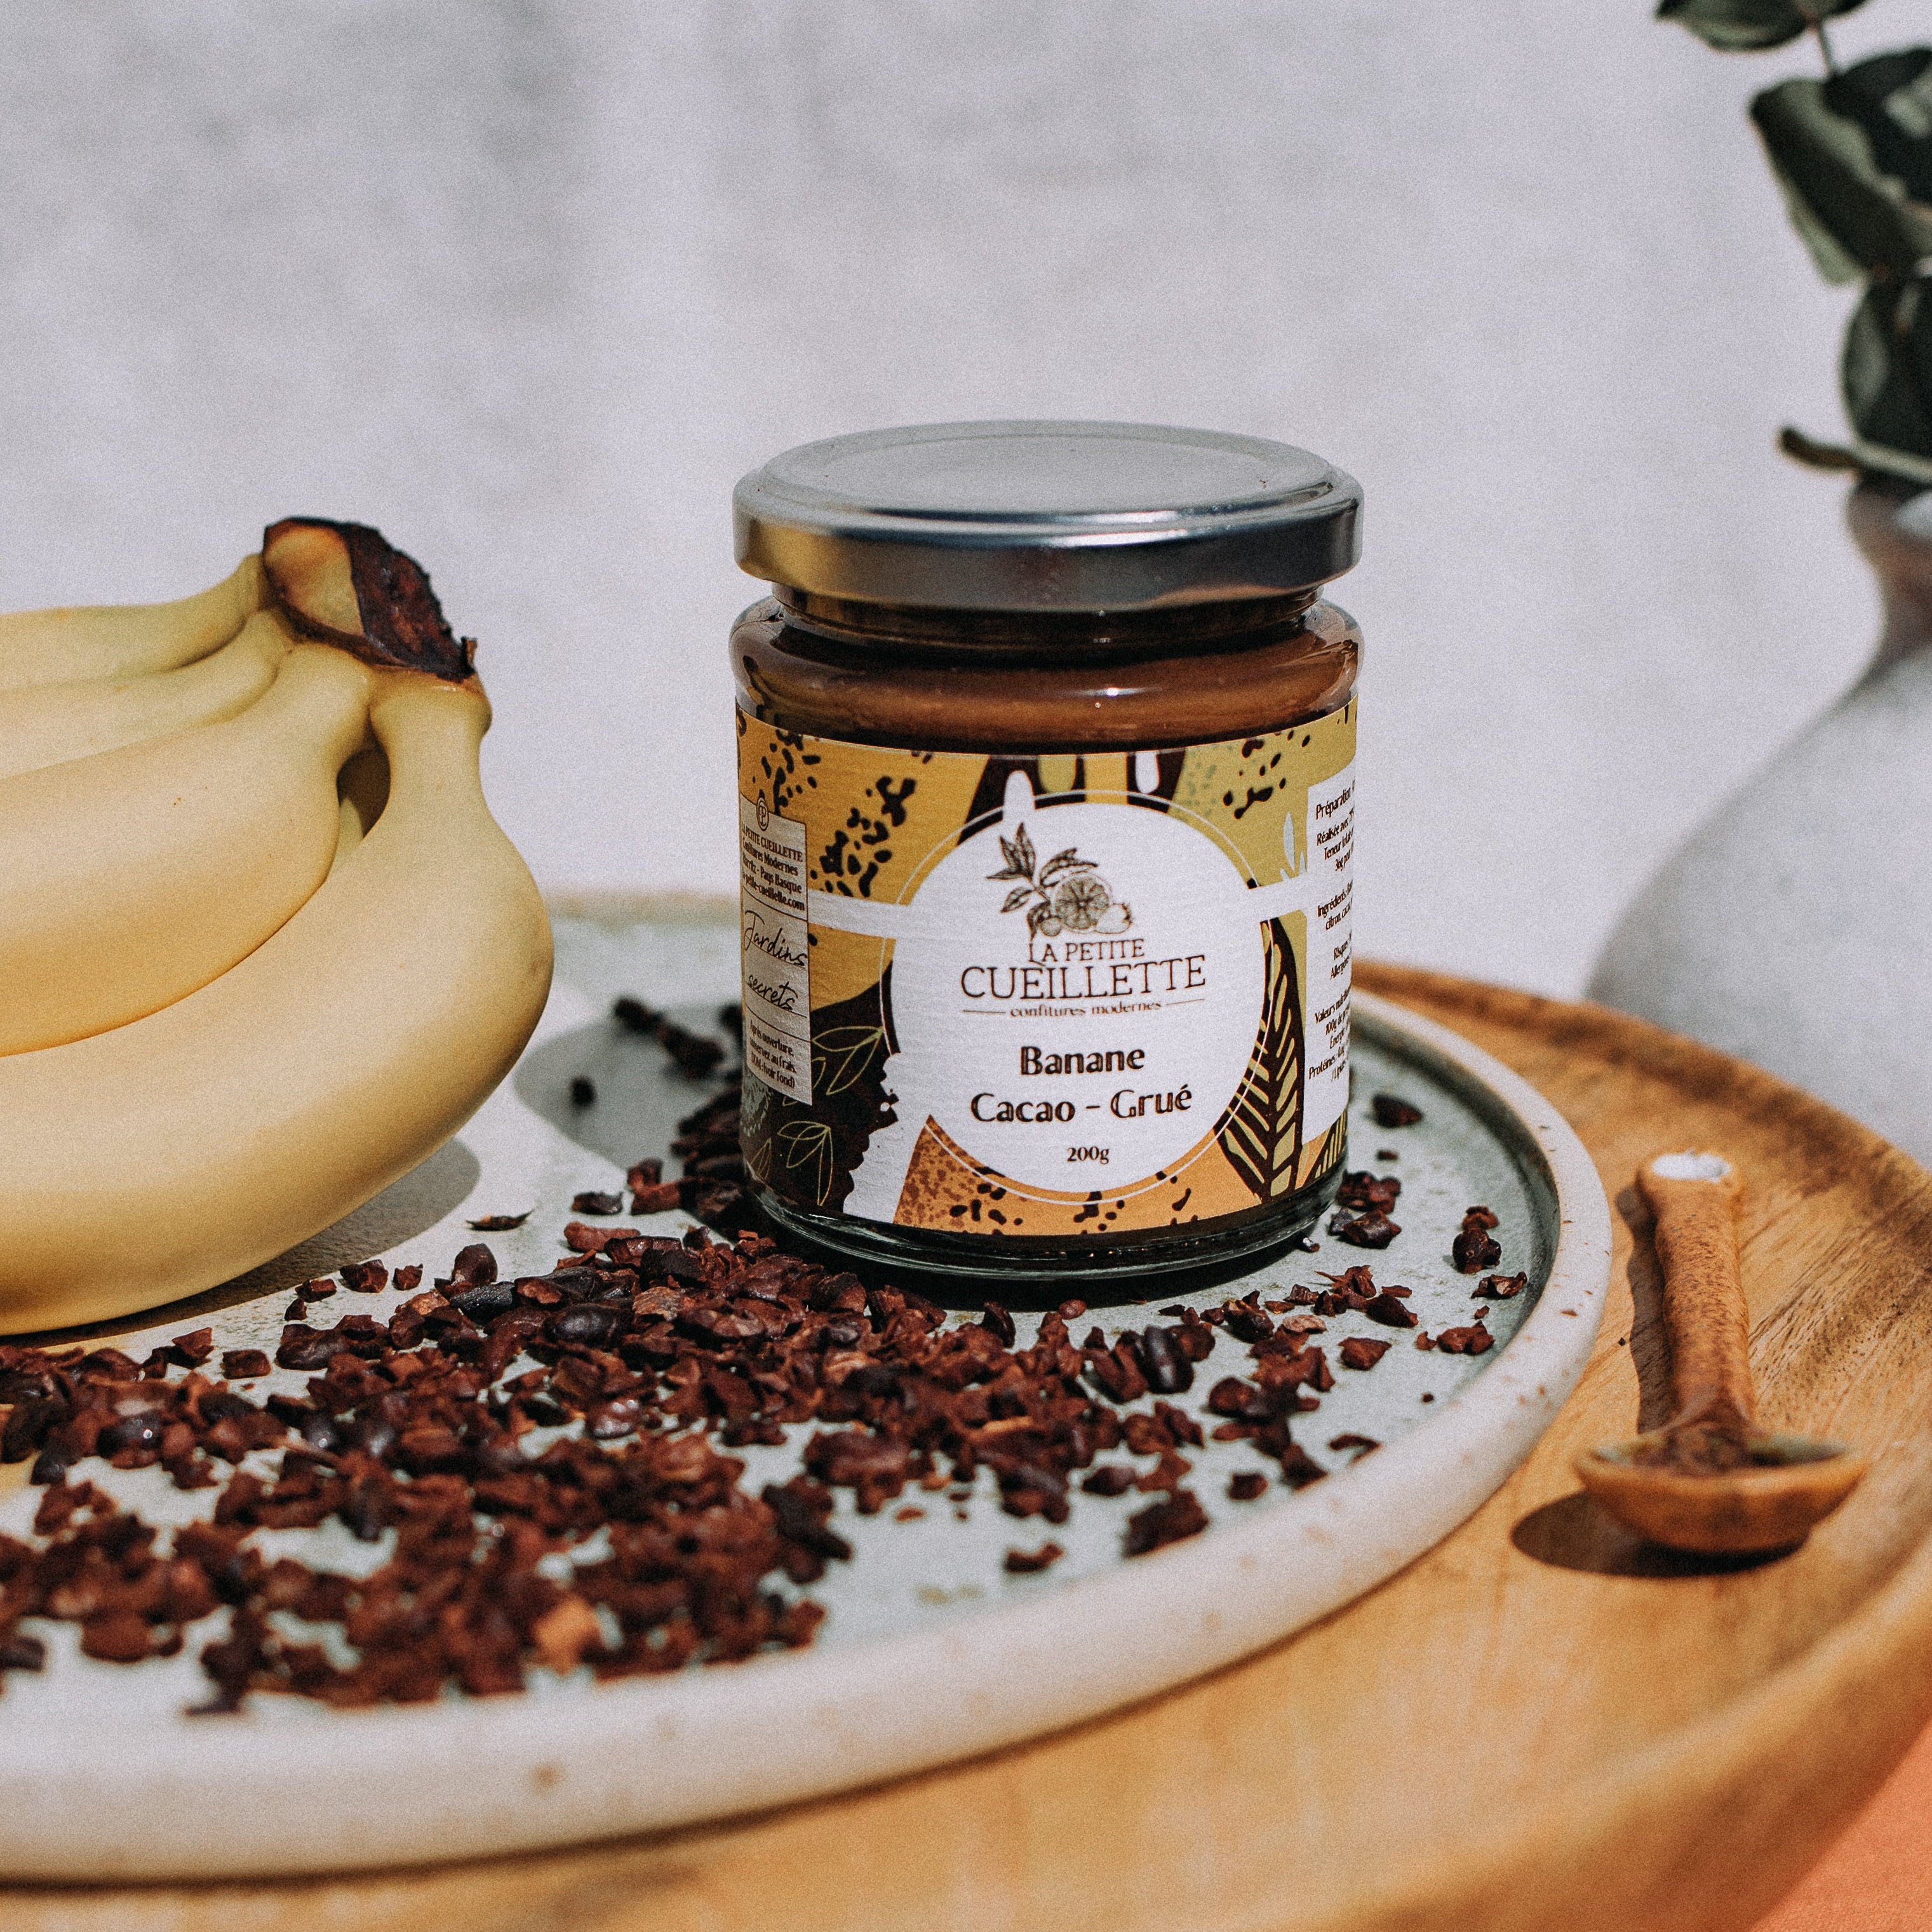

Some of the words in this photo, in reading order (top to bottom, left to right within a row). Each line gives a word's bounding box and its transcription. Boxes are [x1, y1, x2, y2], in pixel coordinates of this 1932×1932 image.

[1316, 786, 1351, 820] Préparation
[746, 825, 761, 846] PETITE
[761, 836, 803, 862] CUEILLETTE
[764, 851, 799, 876] Modernes
[760, 865, 774, 885] Pays
[775, 873, 802, 895] Basque
[744, 909, 807, 967] Jardins
[1028, 941, 1057, 967] LA
[1065, 939, 1145, 963] PETITE
[960, 955, 1206, 1000] CUEILLETTE
[748, 974, 798, 1012] secrets
[1010, 1001, 1086, 1017] confitures
[1091, 1000, 1162, 1015] modernes
[771, 1054, 779, 1066] au
[1020, 1045, 1145, 1076] Banane
[777, 1070, 795, 1089] fond)
[970, 1092, 1076, 1124] Cacao
[1110, 1083, 1193, 1120] Grué
[1066, 1146, 1110, 1165] 200g
